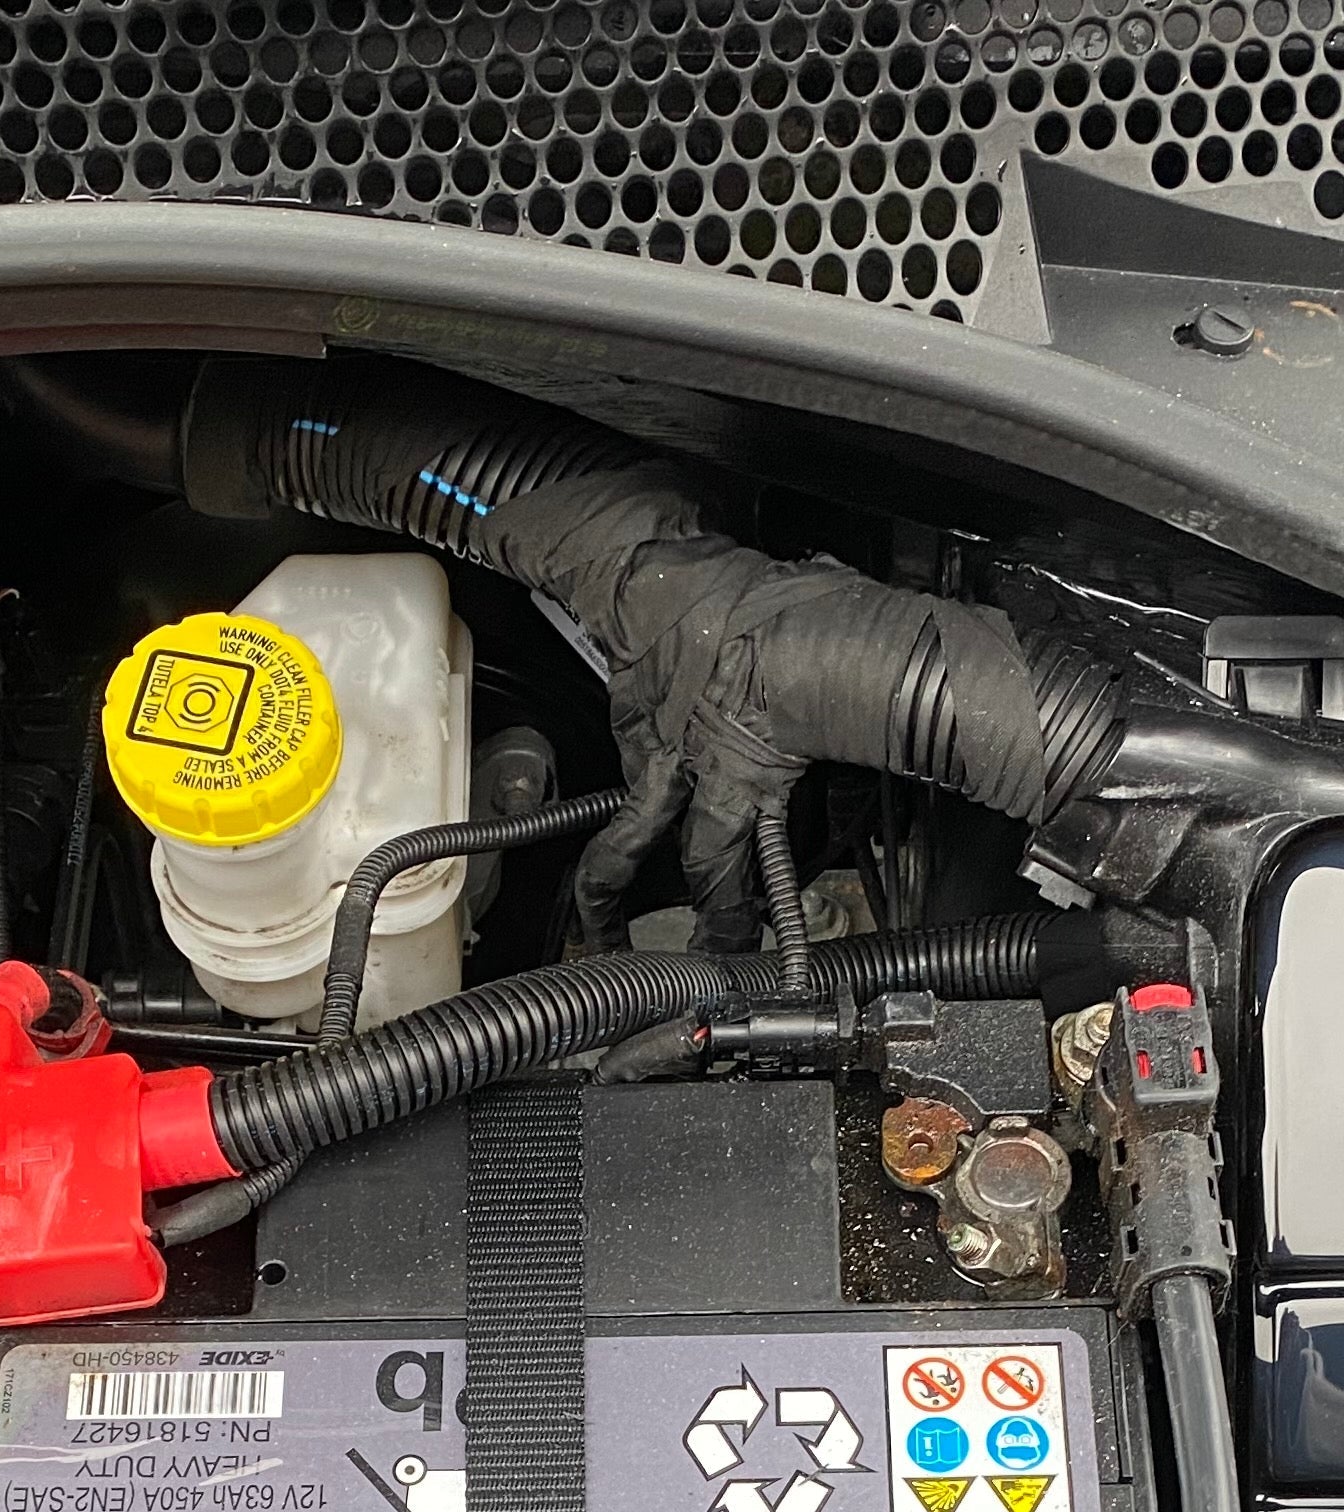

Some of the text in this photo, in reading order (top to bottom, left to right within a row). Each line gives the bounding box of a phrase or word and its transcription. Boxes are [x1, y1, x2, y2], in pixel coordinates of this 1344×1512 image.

[149, 659, 175, 698] TUTELA
[278, 652, 308, 685] CLEAN
[143, 700, 161, 723] TOP
[184, 642, 294, 773] USE ONLY DOT4 FLUID FROM A SEALED
[244, 684, 275, 744] CONTAINER
[296, 688, 312, 726] FILLER
[289, 729, 306, 751] CAP
[173, 771, 242, 790] REMOVING
[247, 750, 291, 785] BEFORE
[72, 1352, 179, 1367] 438450-HD
[199, 1351, 273, 1366] EXIDE
[375, 1350, 468, 1432] b
[70, 1420, 271, 1444] PN: 51816427
[75, 1455, 261, 1478] HEAVY DUTY
[4, 1481, 327, 1512] 12V 63Ah 450A (EN2-SAE)
